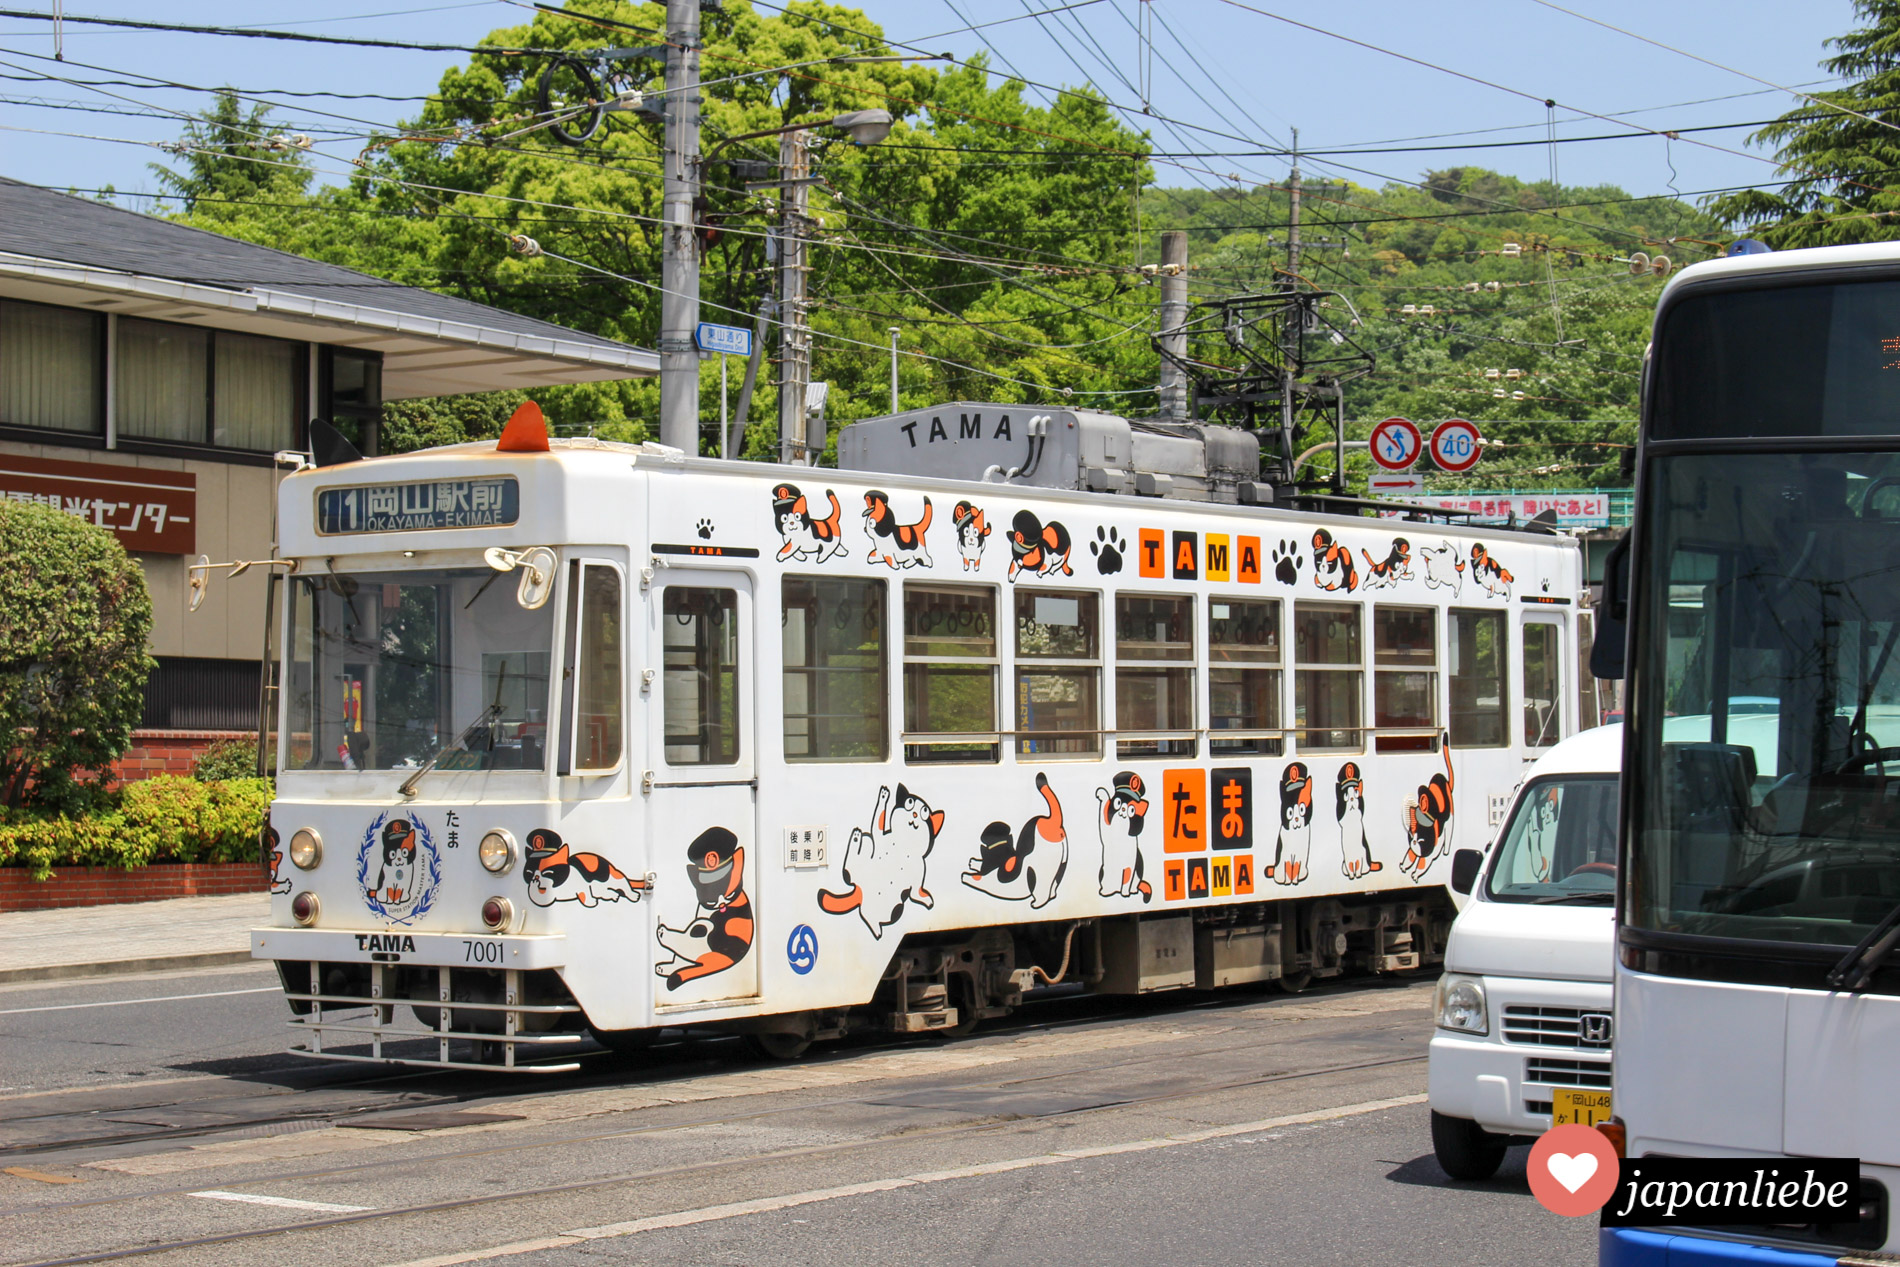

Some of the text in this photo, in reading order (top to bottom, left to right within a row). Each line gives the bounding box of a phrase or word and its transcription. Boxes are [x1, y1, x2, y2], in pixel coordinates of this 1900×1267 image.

[901, 413, 1012, 447] TAMA
[1442, 434, 1470, 457] 40
[345, 490, 357, 529] 1
[368, 480, 504, 517] 岡山駅前
[367, 510, 503, 531] OKAYAMA-EKIMAE
[690, 546, 722, 555] TAMA
[1144, 540, 1257, 573] TAMA
[1172, 779, 1244, 839] たま
[446, 810, 460, 849] たま
[790, 830, 824, 843] 後乗り
[1168, 864, 1251, 891] TAMA
[355, 934, 416, 952] TAMA
[462, 941, 504, 963] 7001
